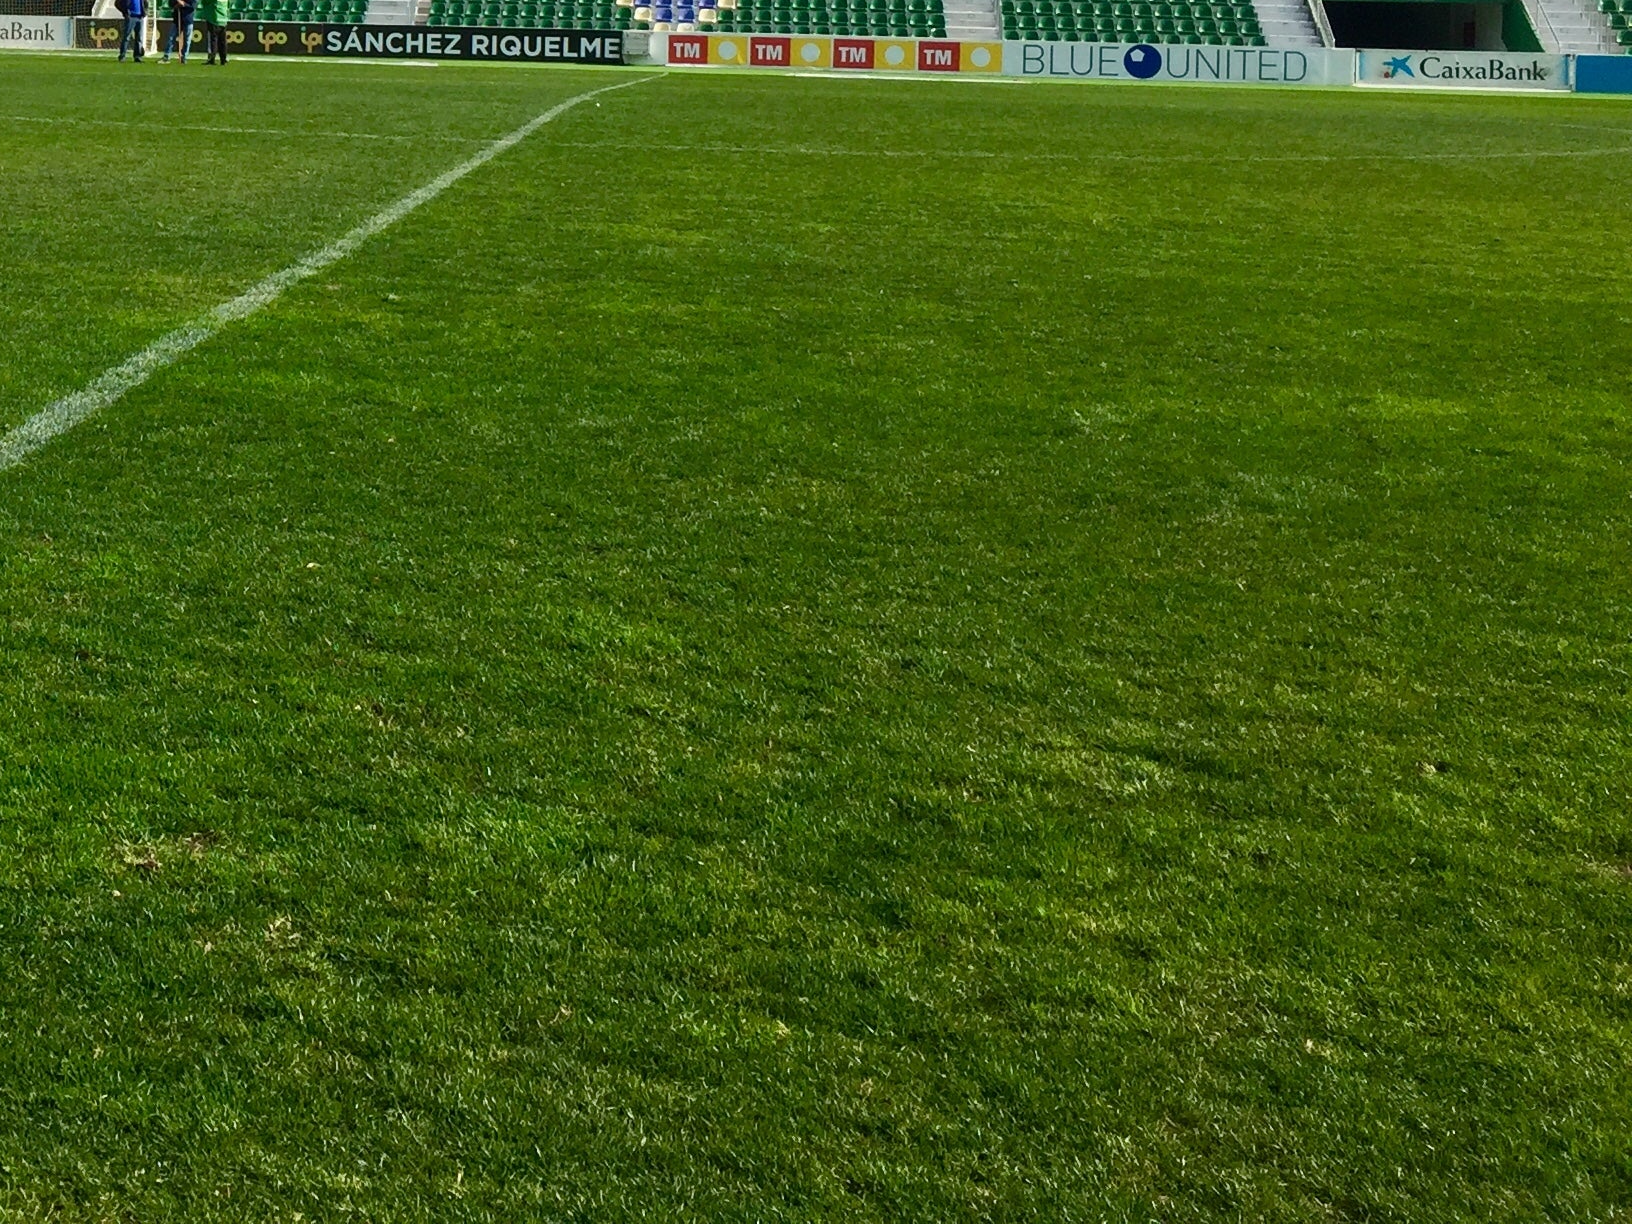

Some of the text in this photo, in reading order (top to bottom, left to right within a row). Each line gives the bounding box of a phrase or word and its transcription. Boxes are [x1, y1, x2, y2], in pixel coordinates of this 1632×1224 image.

[326, 26, 621, 60] SÁNCHEZ RIQUELME
[673, 42, 700, 58] TM
[755, 44, 783, 61] TM
[838, 46, 867, 63] TM
[923, 49, 952, 66] TM
[1022, 43, 1308, 82] BLUE UNITED
[1419, 56, 1549, 82] CaixaBank
